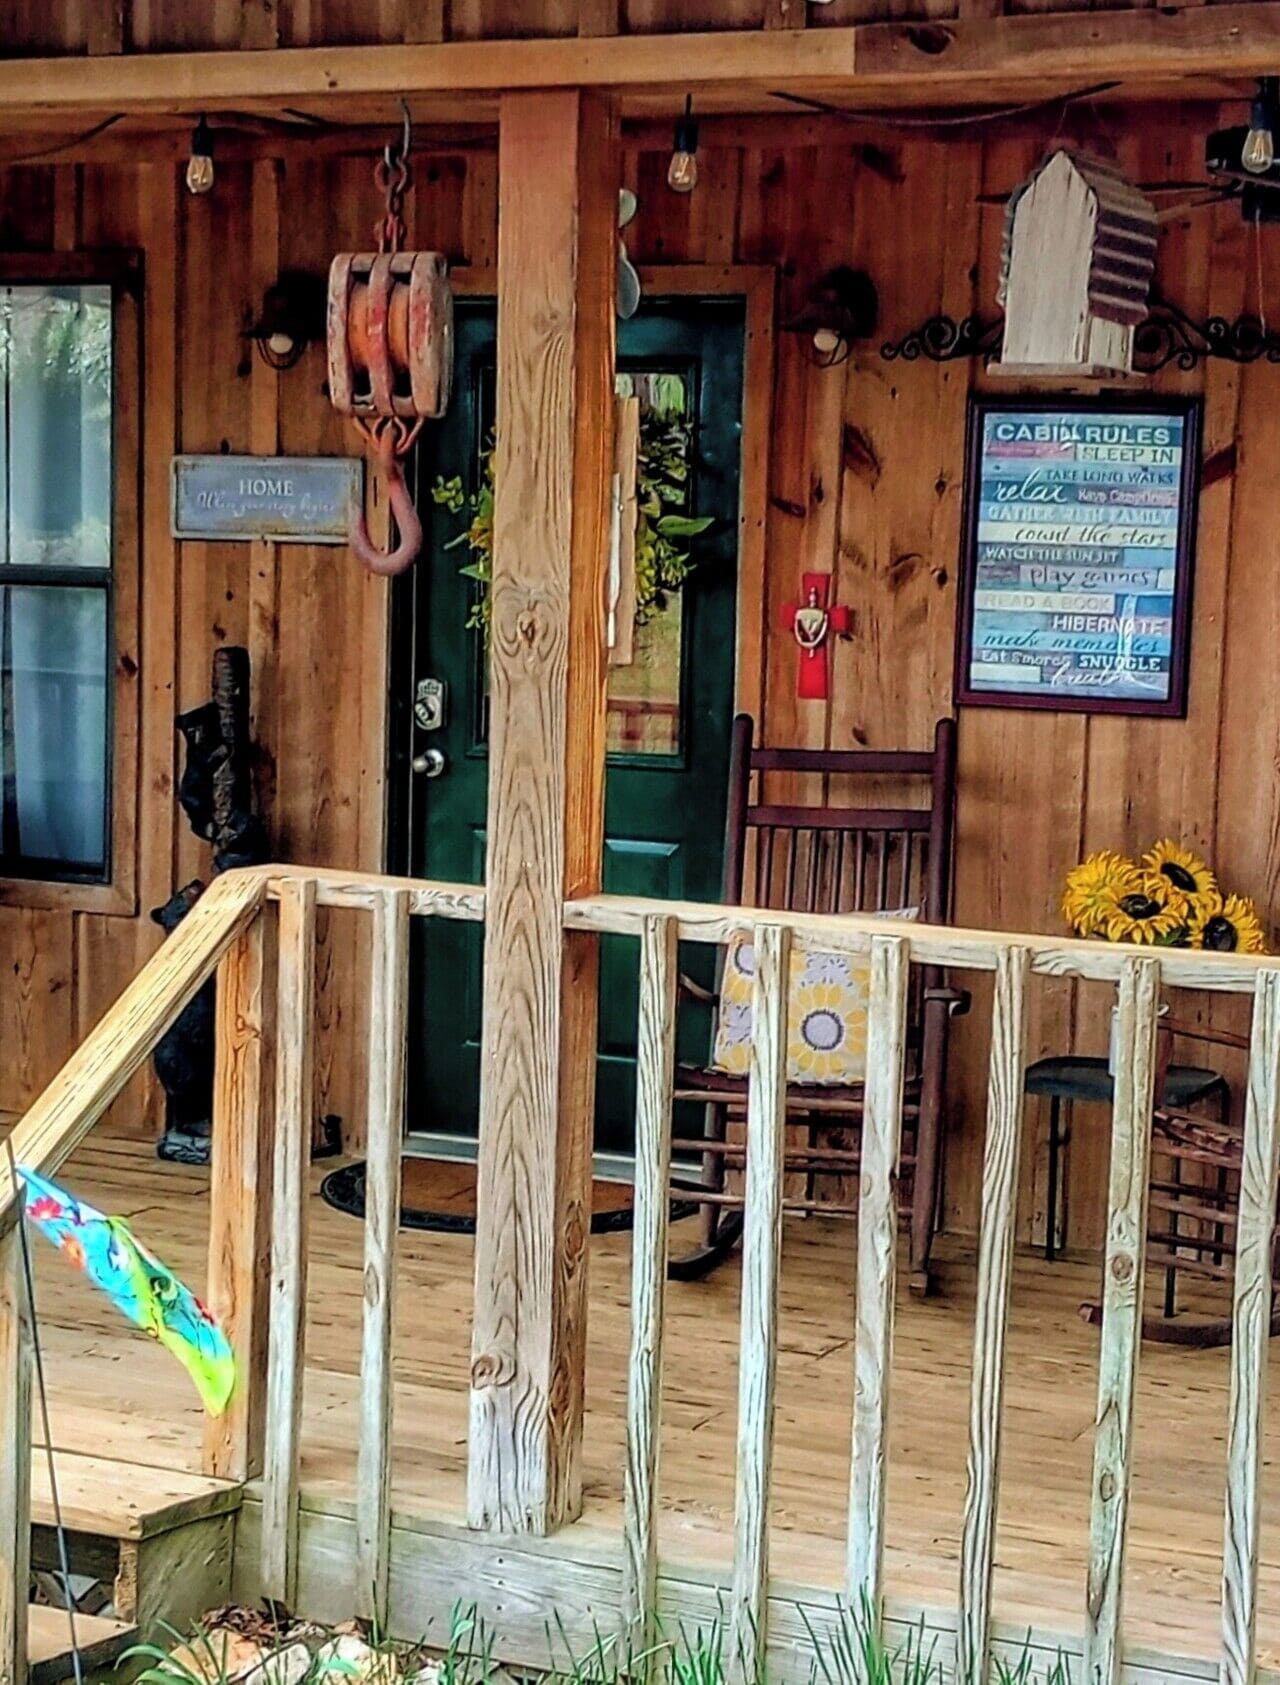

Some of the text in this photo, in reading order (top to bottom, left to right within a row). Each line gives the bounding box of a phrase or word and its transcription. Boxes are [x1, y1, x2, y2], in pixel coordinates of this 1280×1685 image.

[996, 422, 1170, 444] CABIN RULES
[1082, 446, 1174, 463] SLEEP IN
[994, 467, 1068, 503] relax
[1046, 469, 1173, 484] TAKE LONG WALKS
[239, 479, 294, 496] HOME
[988, 503, 1170, 524] GATHER WITH FAMILY
[1015, 523, 1167, 546] count the stars
[985, 546, 1033, 560] WATCH
[1035, 549, 1062, 561] THE
[1030, 565, 1148, 591] play games
[984, 595, 1110, 610] READ A BOOK
[1053, 615, 1163, 635] HIBERNATE
[984, 629, 1158, 652] make memoies
[1079, 655, 1161, 671] SNUGGLE
